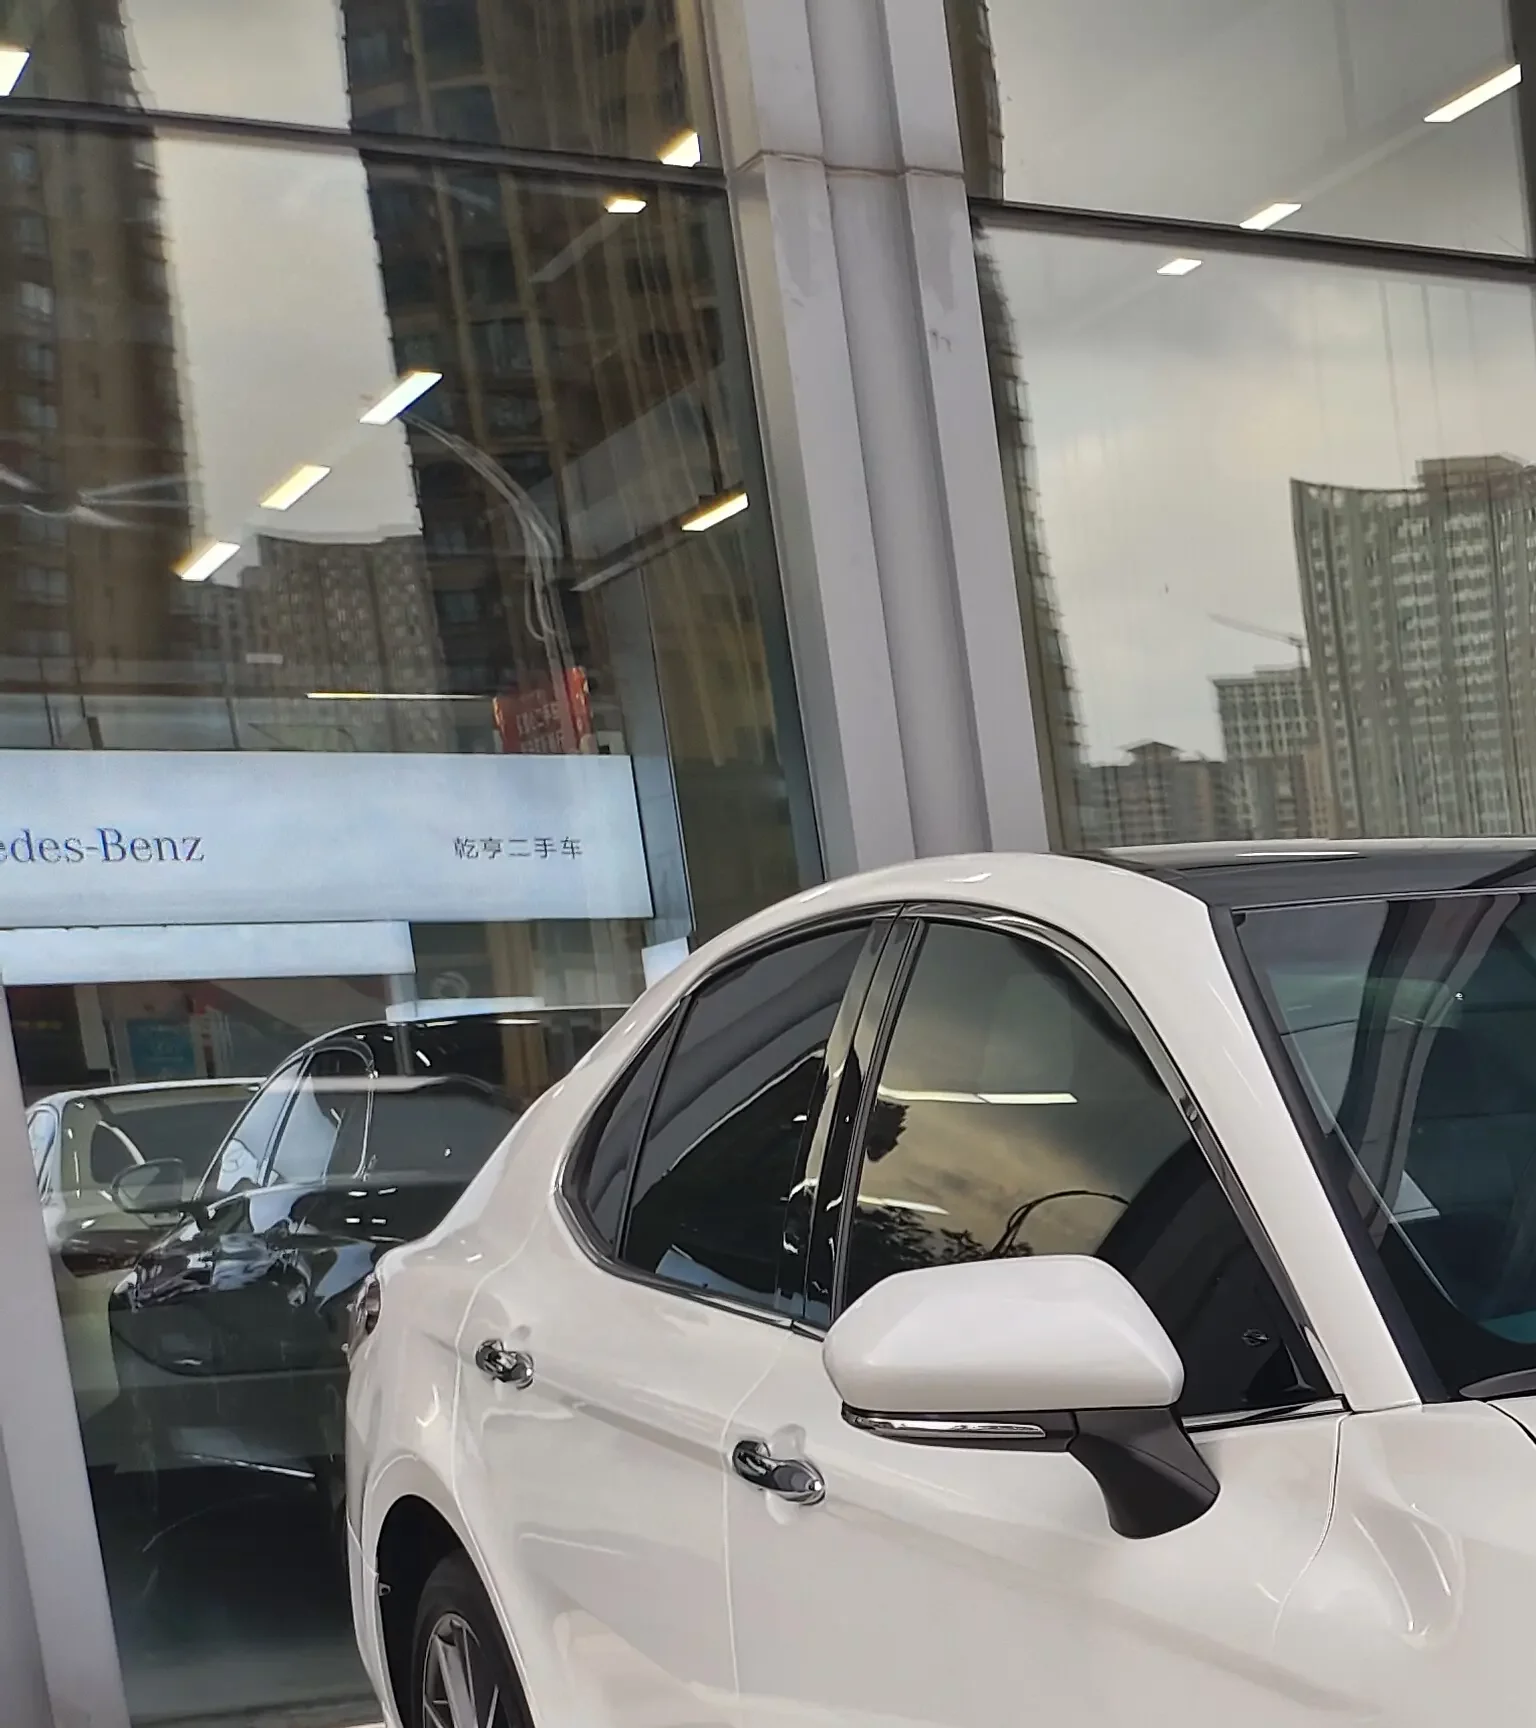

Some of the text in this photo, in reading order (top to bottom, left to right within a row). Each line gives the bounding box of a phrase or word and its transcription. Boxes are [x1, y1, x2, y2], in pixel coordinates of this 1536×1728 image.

[453, 835, 584, 860] 乾亨二手车
